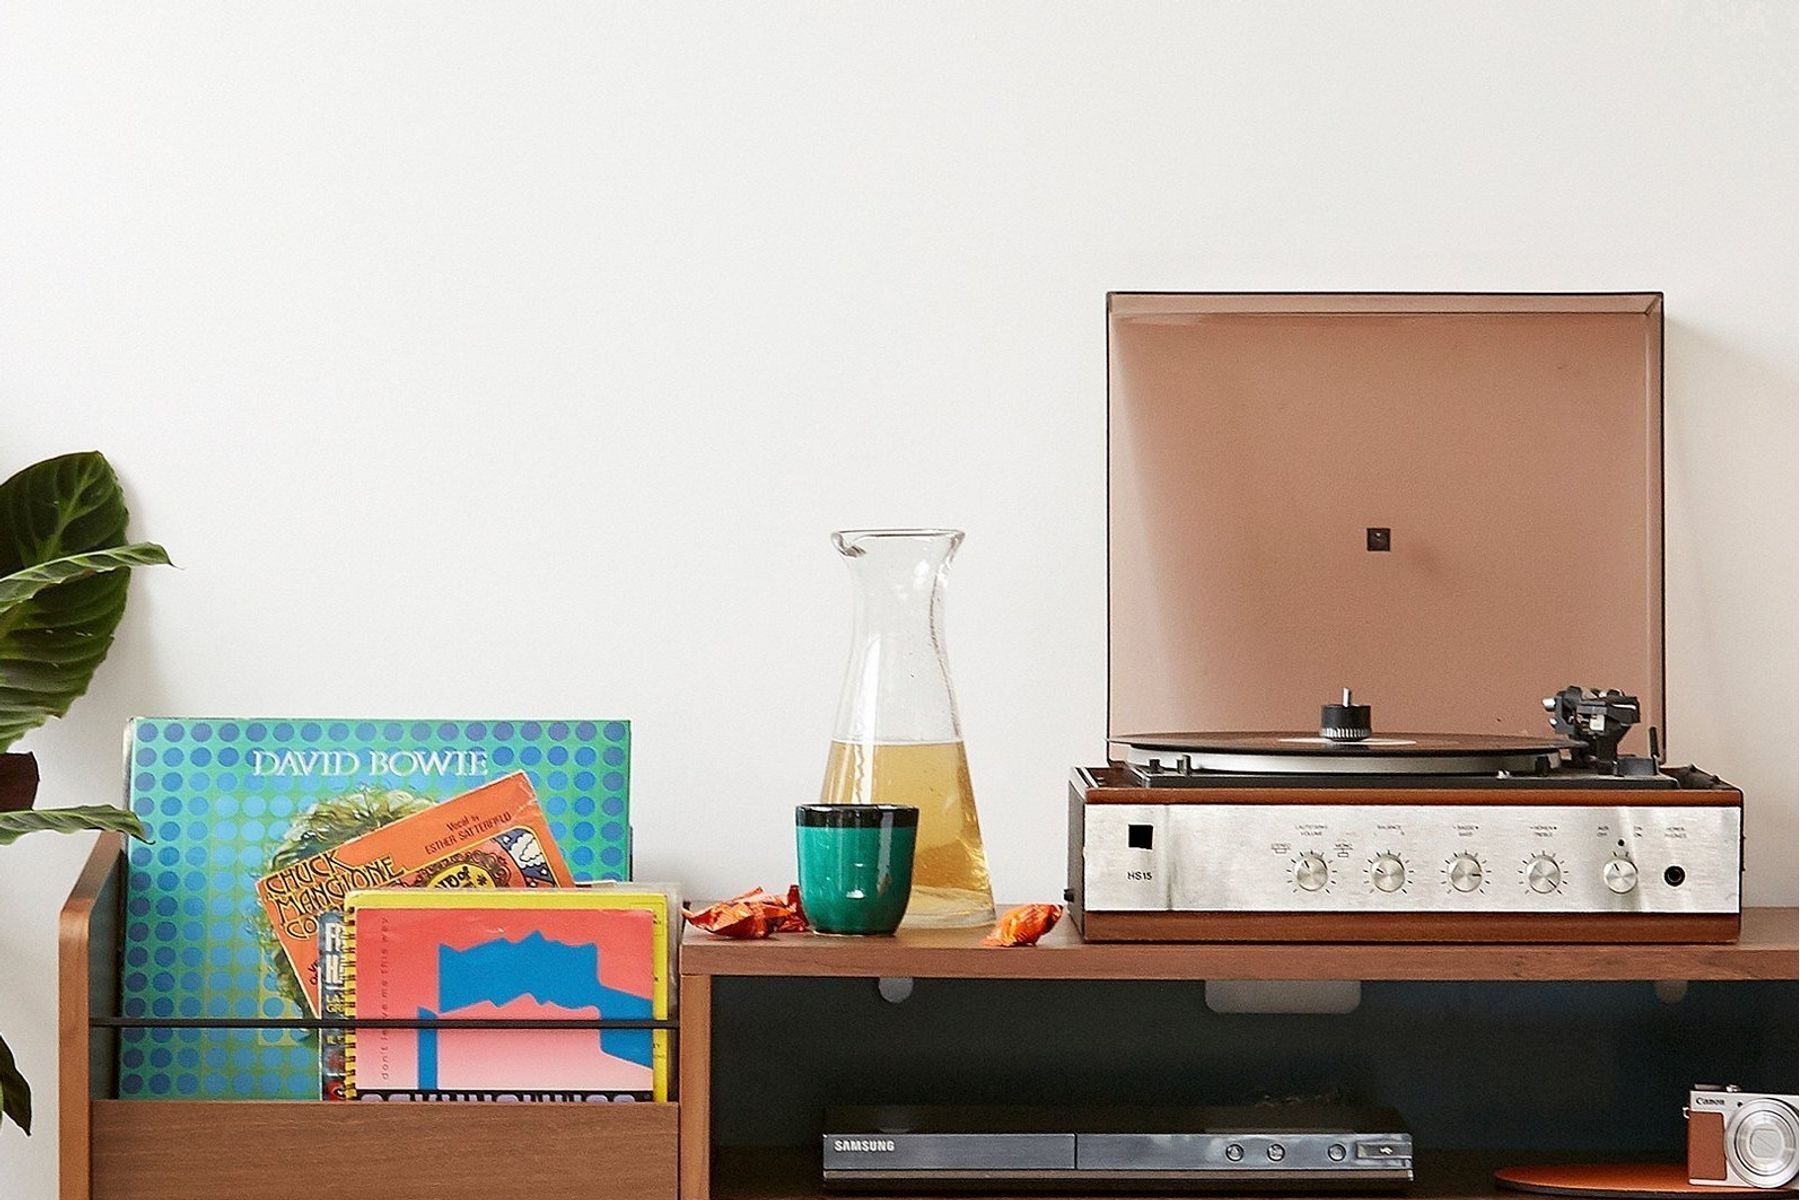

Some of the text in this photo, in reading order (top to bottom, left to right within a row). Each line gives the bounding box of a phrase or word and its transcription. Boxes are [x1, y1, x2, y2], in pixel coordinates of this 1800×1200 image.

[252, 750, 489, 776] DAVID BOWIE
[424, 835, 458, 855] ESTHER
[265, 850, 352, 895] CHUCK
[1127, 871, 1153, 881] HS15
[276, 856, 405, 925] MANGIONE
[380, 1004, 389, 1041] leve
[834, 1140, 895, 1152] SAMSUNG
